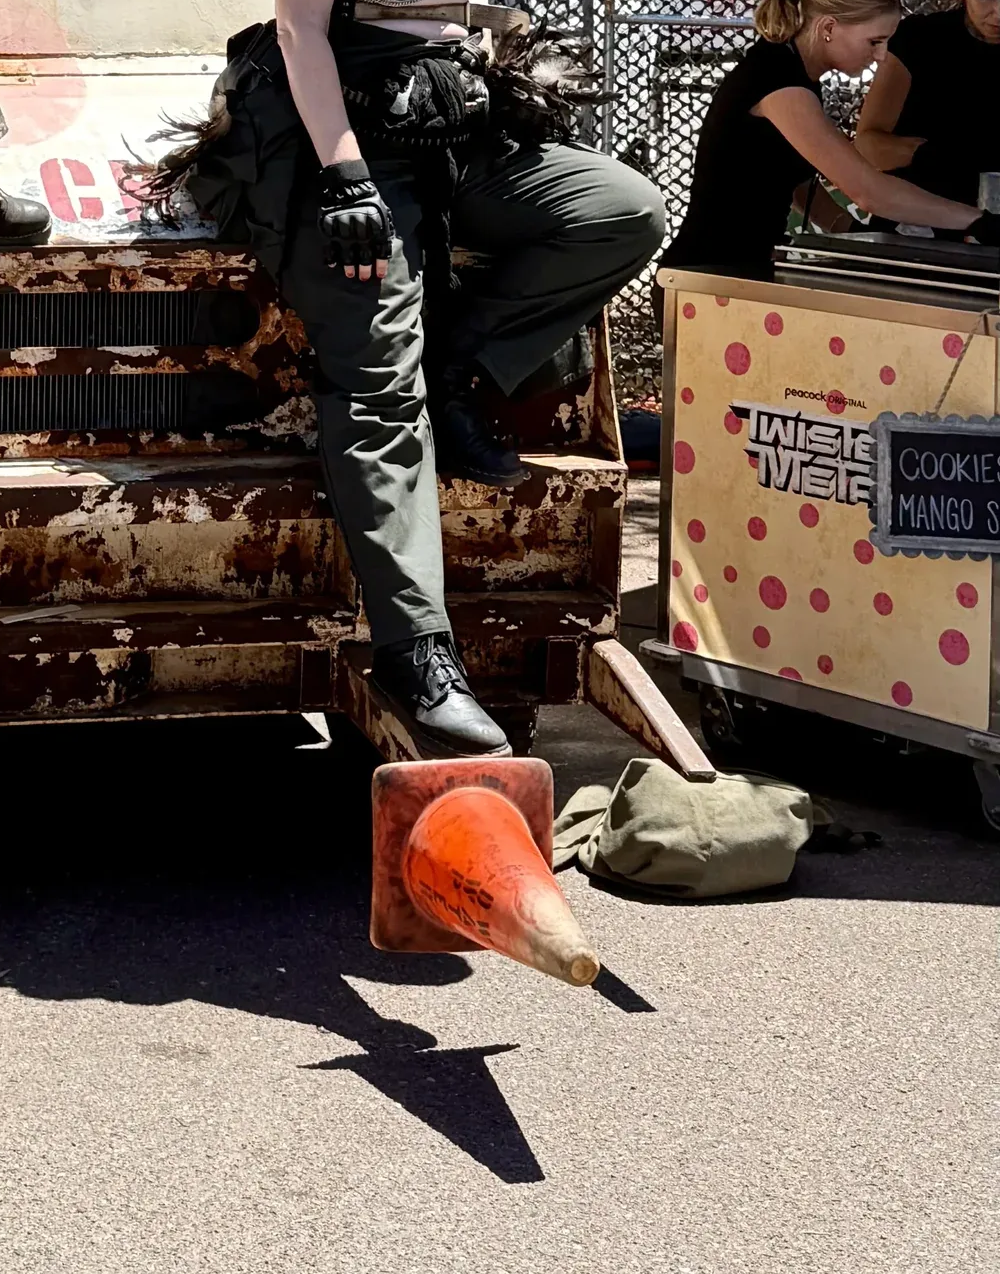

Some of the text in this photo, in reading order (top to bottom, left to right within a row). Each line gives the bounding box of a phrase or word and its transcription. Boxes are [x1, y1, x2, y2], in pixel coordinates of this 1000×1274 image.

[784, 387, 867, 409] peacock ORIGINAL
[728, 399, 877, 463] TWISTE
[743, 442, 877, 509] META
[899, 447, 1000, 483] COOKIE
[899, 493, 974, 532] MANGO
